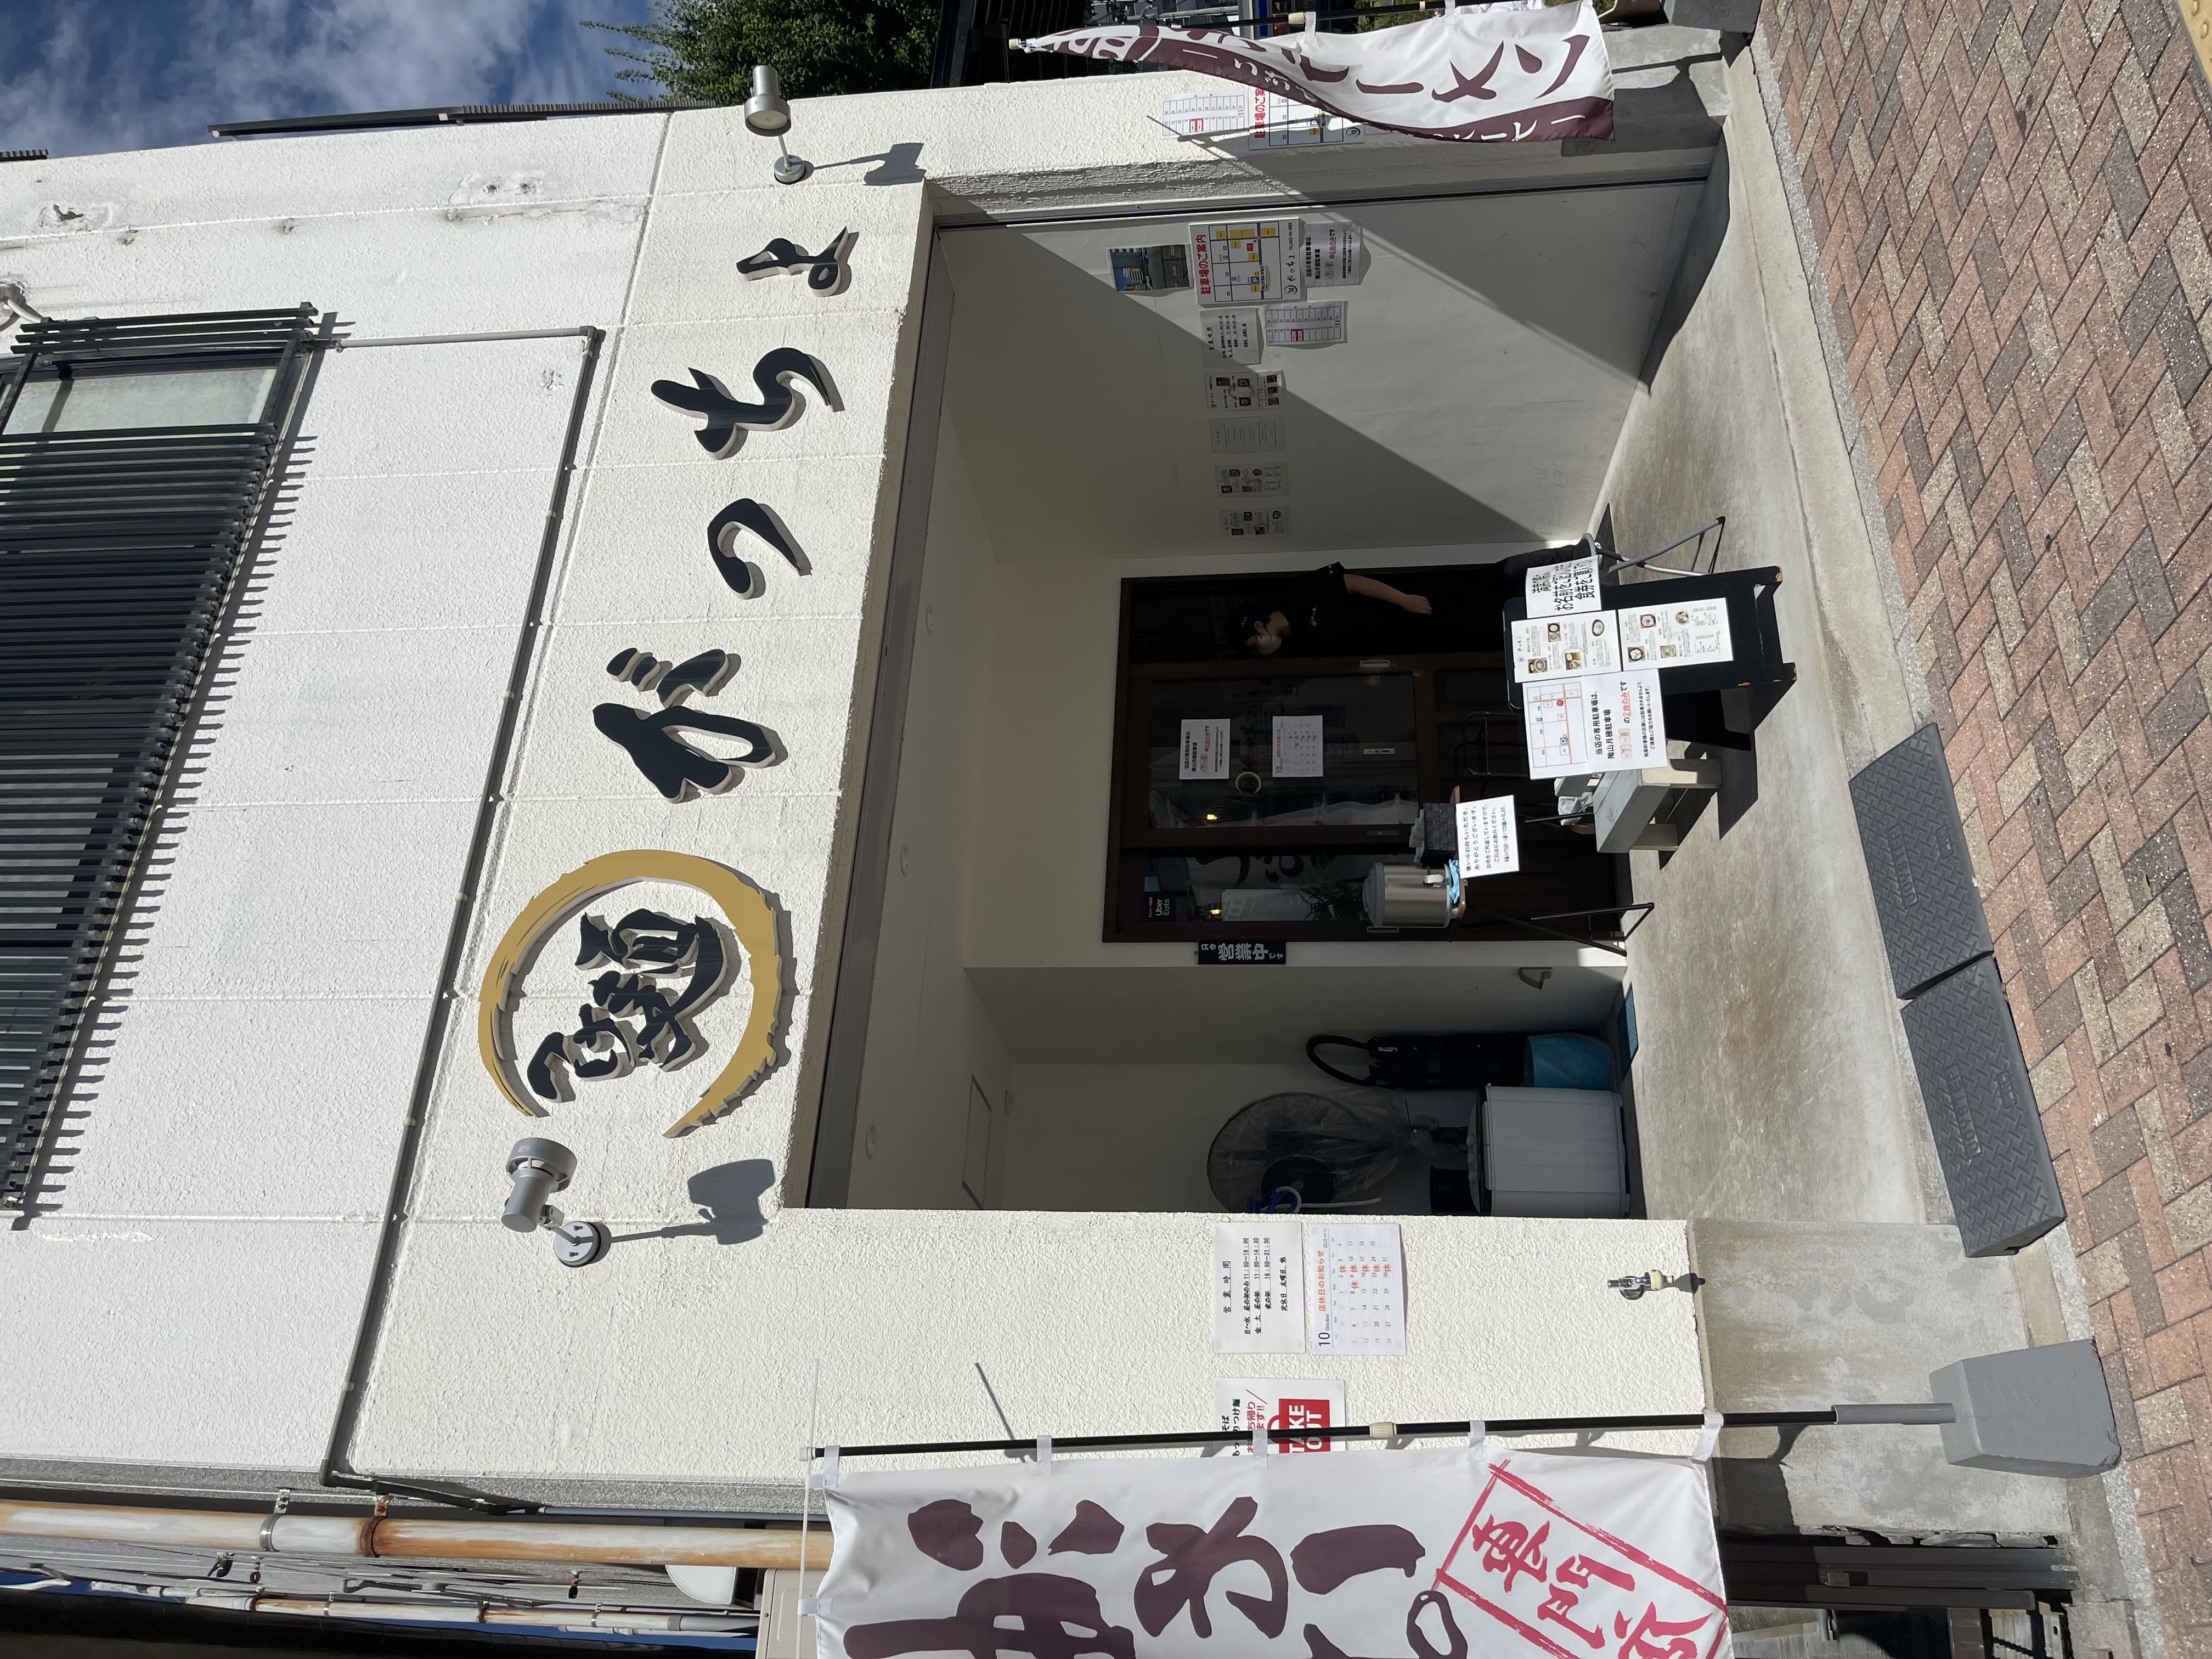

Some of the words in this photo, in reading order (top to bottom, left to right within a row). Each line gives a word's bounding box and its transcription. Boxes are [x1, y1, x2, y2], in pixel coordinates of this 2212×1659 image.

[1254, 87, 1266, 139] 駐車場のご案
[1195, 234, 1211, 295] 駐車場のご案内
[1285, 254, 1296, 282] がっちょ
[592, 226, 849, 800] がっちょ
[1590, 690, 1603, 755] 当店の専用駐車場は、
[1620, 681, 1631, 724] の2台のみです
[1471, 805, 1480, 870] ありがとうございます。
[1492, 806, 1500, 862] ご自由にお飲みください。
[1316, 1250, 1326, 1312] 店休日のお知らせ
[1339, 1265, 1346, 1273] 休
[1349, 1265, 1358, 1273] 休
[1351, 1280, 1359, 1289] 休
[1361, 1265, 1369, 1273] 休
[1373, 1264, 1381, 1272] 休
[1383, 1264, 1391, 1272] 休
[1318, 1331, 1330, 1347] 10
[1221, 1415, 1230, 1432] そば
[1232, 1398, 1241, 1456] あっりつけ麺
[1246, 1401, 1256, 1453] おち帰り
